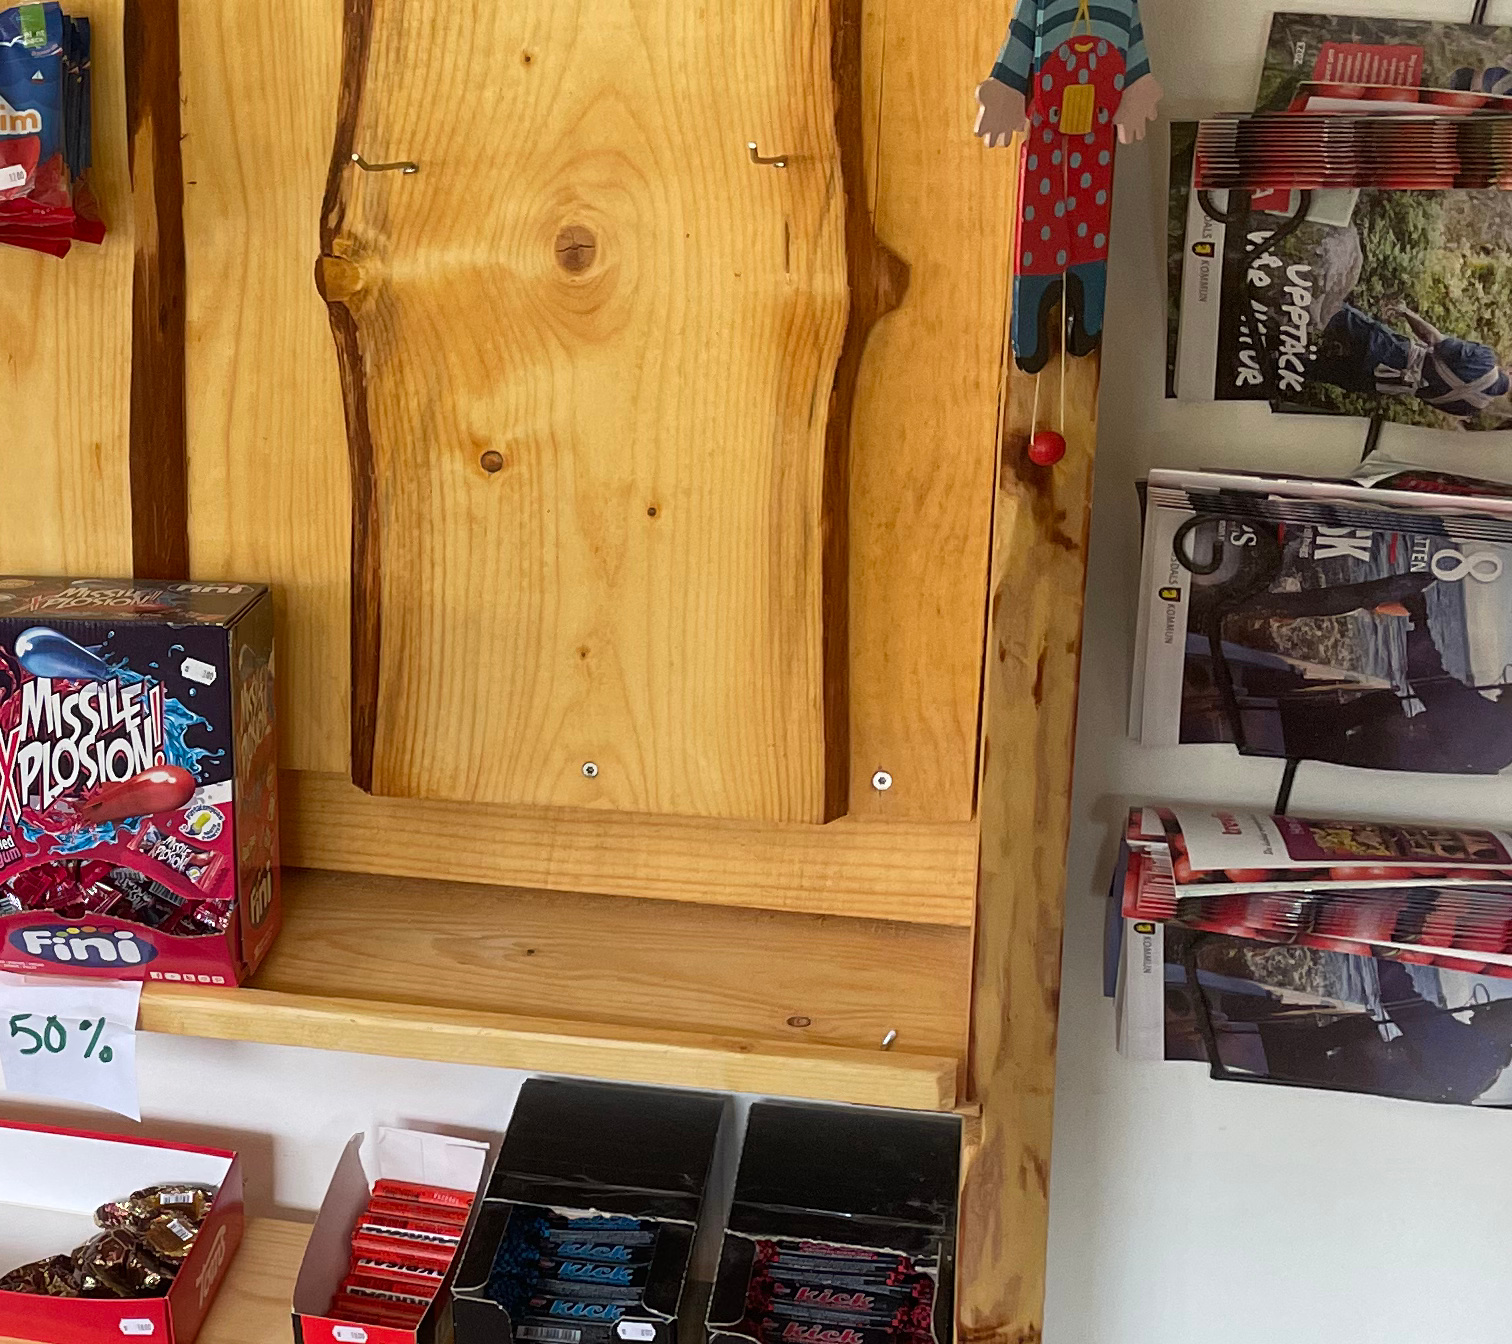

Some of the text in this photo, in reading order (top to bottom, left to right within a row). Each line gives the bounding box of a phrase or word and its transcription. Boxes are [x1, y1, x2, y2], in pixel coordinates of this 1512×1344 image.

[1197, 260, 1211, 303] KOMMUN
[1277, 264, 1322, 393] UPPTÄCK
[1163, 602, 1176, 645] KOMMUN
[17, 677, 144, 746] MISSILE
[22, 929, 142, 964] Fini
[9, 1013, 114, 1063] 50%
[558, 1240, 633, 1262] kick
[557, 1260, 635, 1286] kick
[549, 1298, 626, 1322] kick
[794, 1286, 876, 1311] kick
